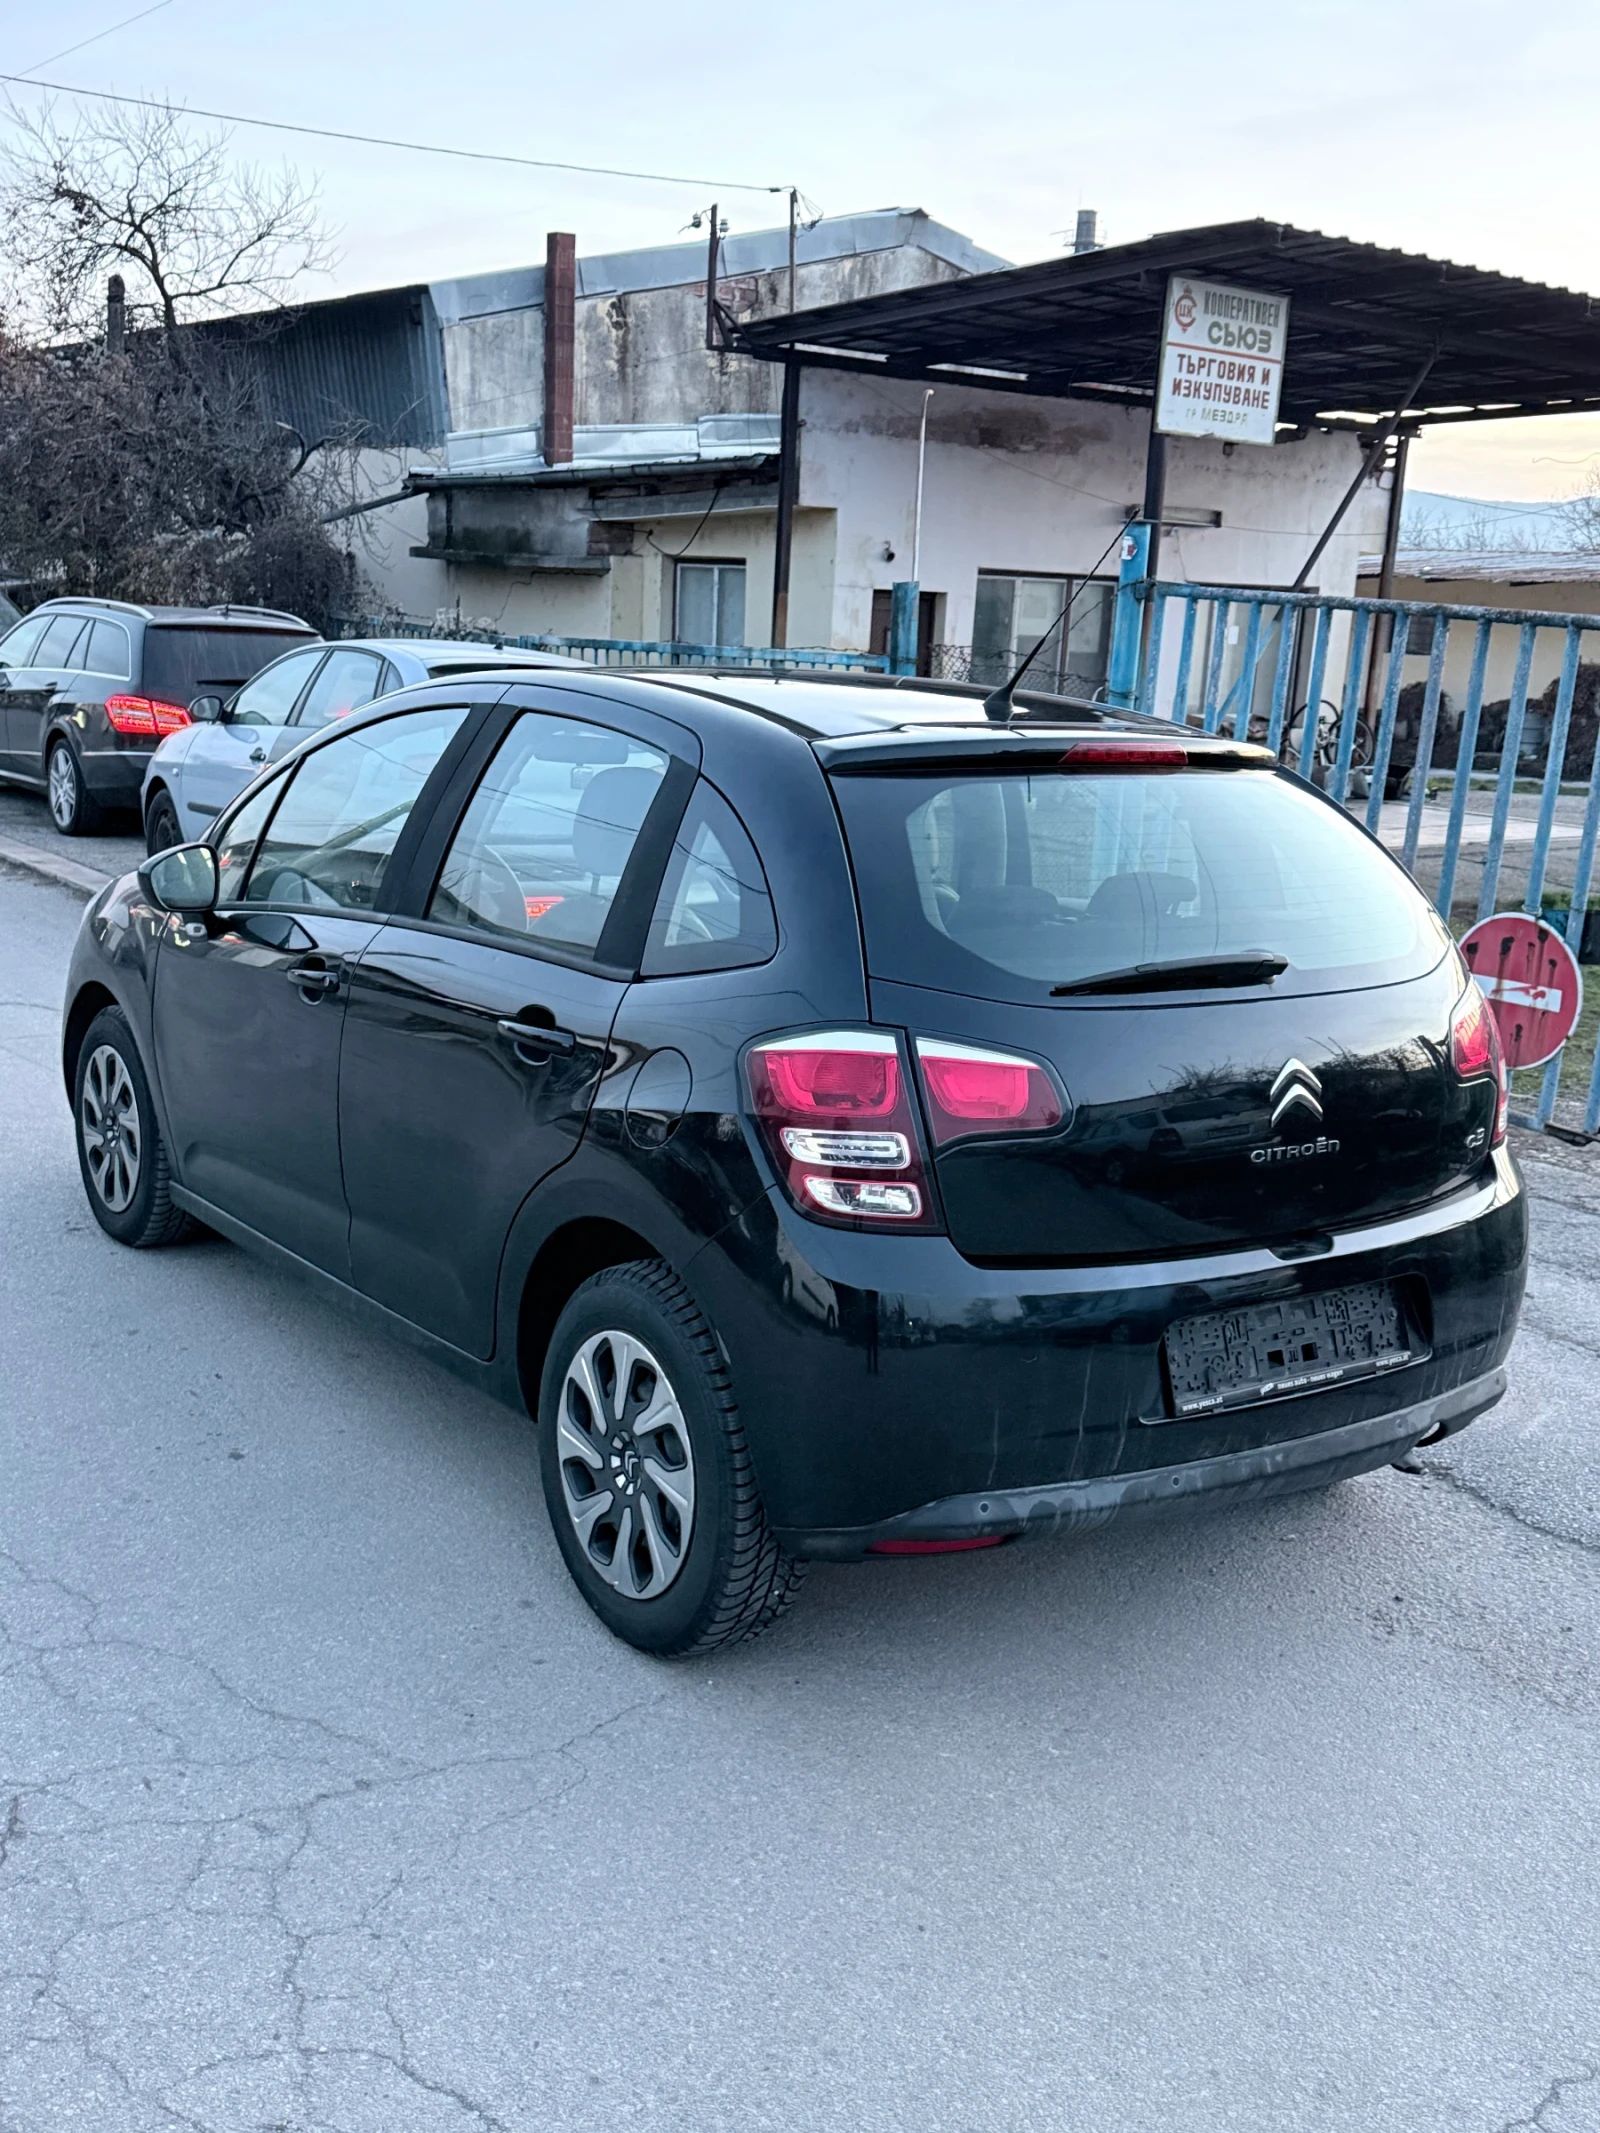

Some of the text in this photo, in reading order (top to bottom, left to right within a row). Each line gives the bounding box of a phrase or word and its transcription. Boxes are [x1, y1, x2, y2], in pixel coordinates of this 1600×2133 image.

[1204, 290, 1280, 328] КООПЕРАТИВЕН
[1261, 367, 1271, 386] И
[1172, 378, 1271, 410] ИЗКУПУВАНЕ
